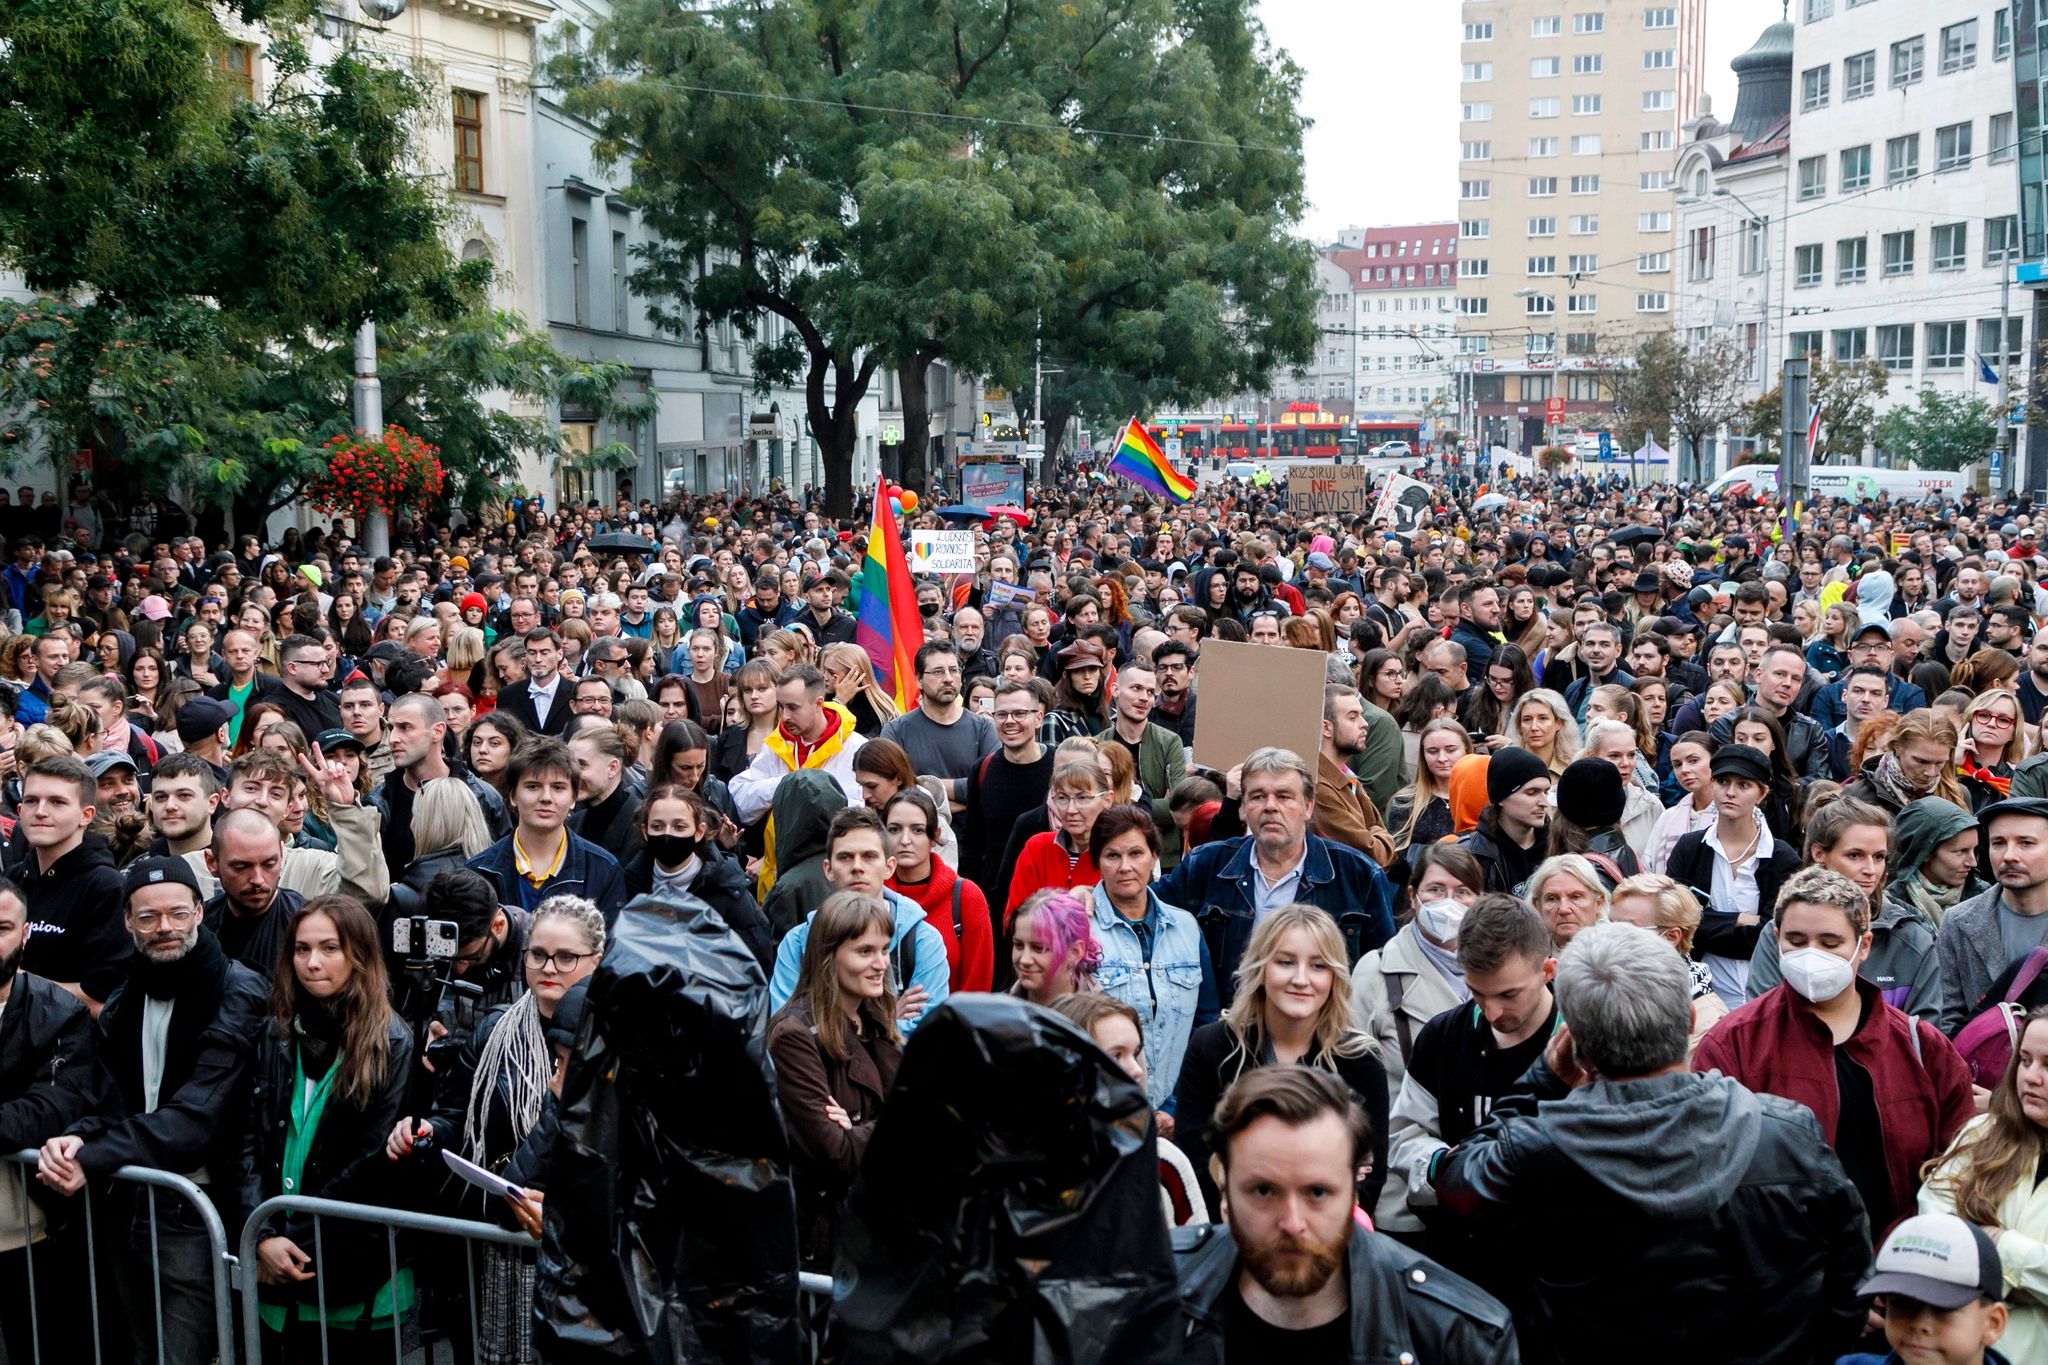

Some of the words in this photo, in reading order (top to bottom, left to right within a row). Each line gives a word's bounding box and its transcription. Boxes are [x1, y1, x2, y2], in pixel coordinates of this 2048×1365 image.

[1992, 453, 1999, 467] P
[1311, 479, 1337, 493] NIE
[1918, 479, 1953, 488] JUTEX
[27, 920, 66, 940] pion
